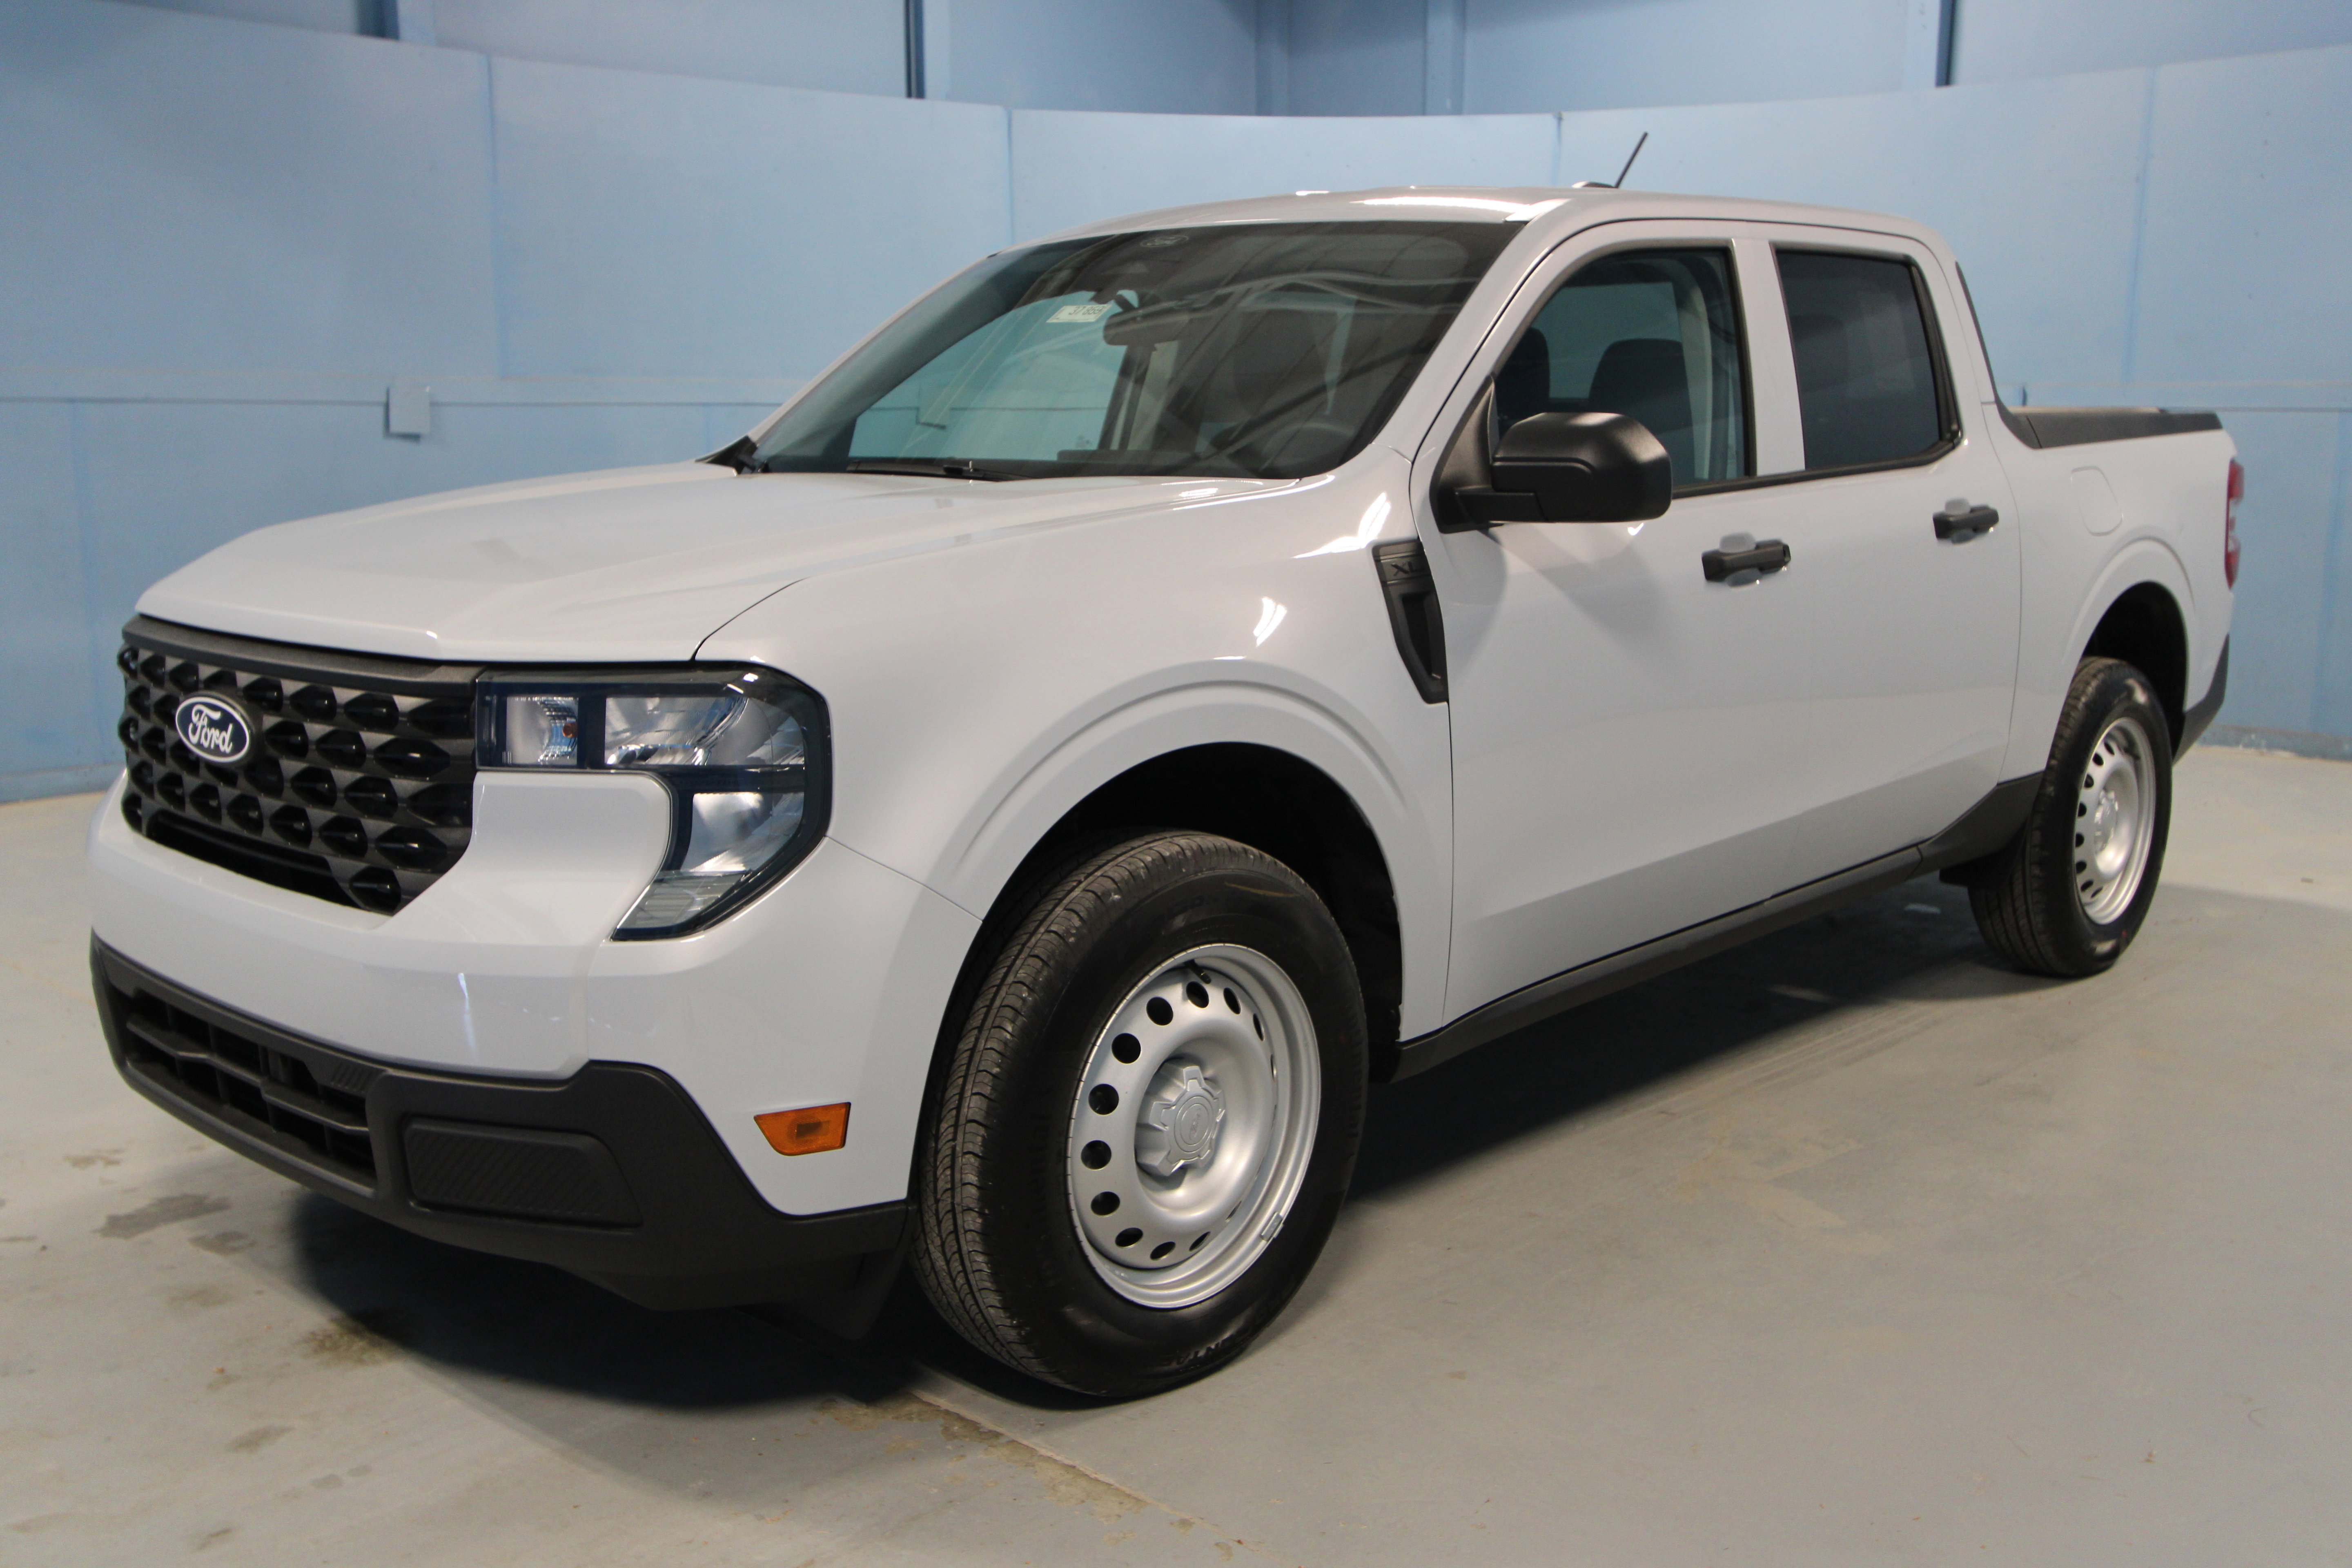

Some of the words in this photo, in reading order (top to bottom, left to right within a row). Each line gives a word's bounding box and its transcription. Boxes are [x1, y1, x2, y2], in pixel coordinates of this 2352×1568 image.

[1068, 306, 1086, 315] 37
[1391, 561, 1425, 576] XL
[188, 704, 233, 754] Ford
